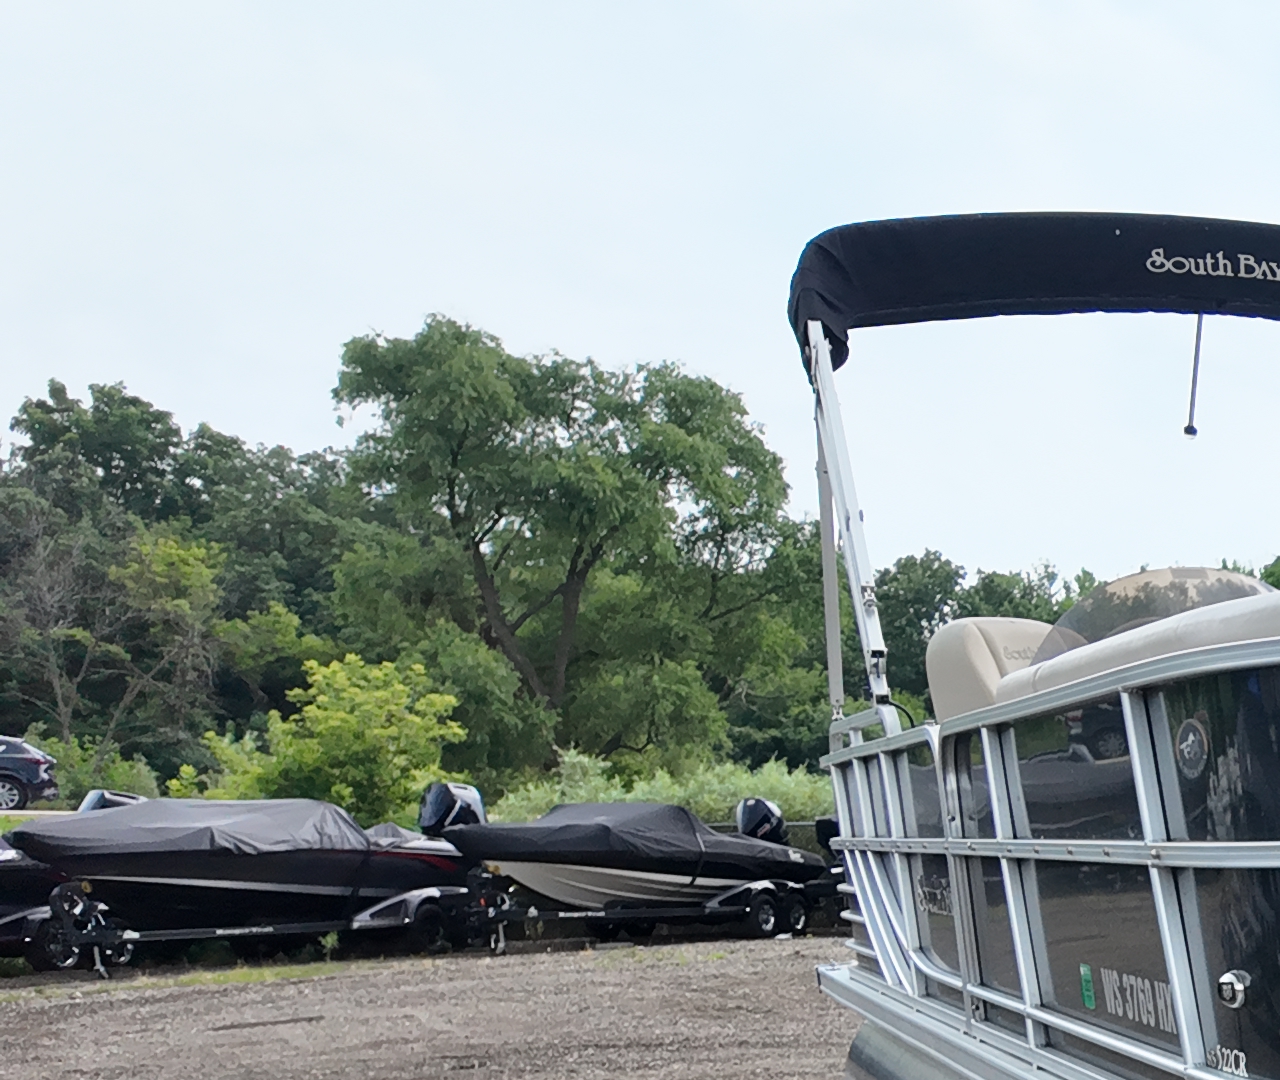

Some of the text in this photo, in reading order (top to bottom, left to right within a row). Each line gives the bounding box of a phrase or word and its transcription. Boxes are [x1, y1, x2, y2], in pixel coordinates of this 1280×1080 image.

[1146, 248, 1234, 277] South
[1100, 967, 1124, 1017] WS
[1122, 973, 1155, 1028] 3769
